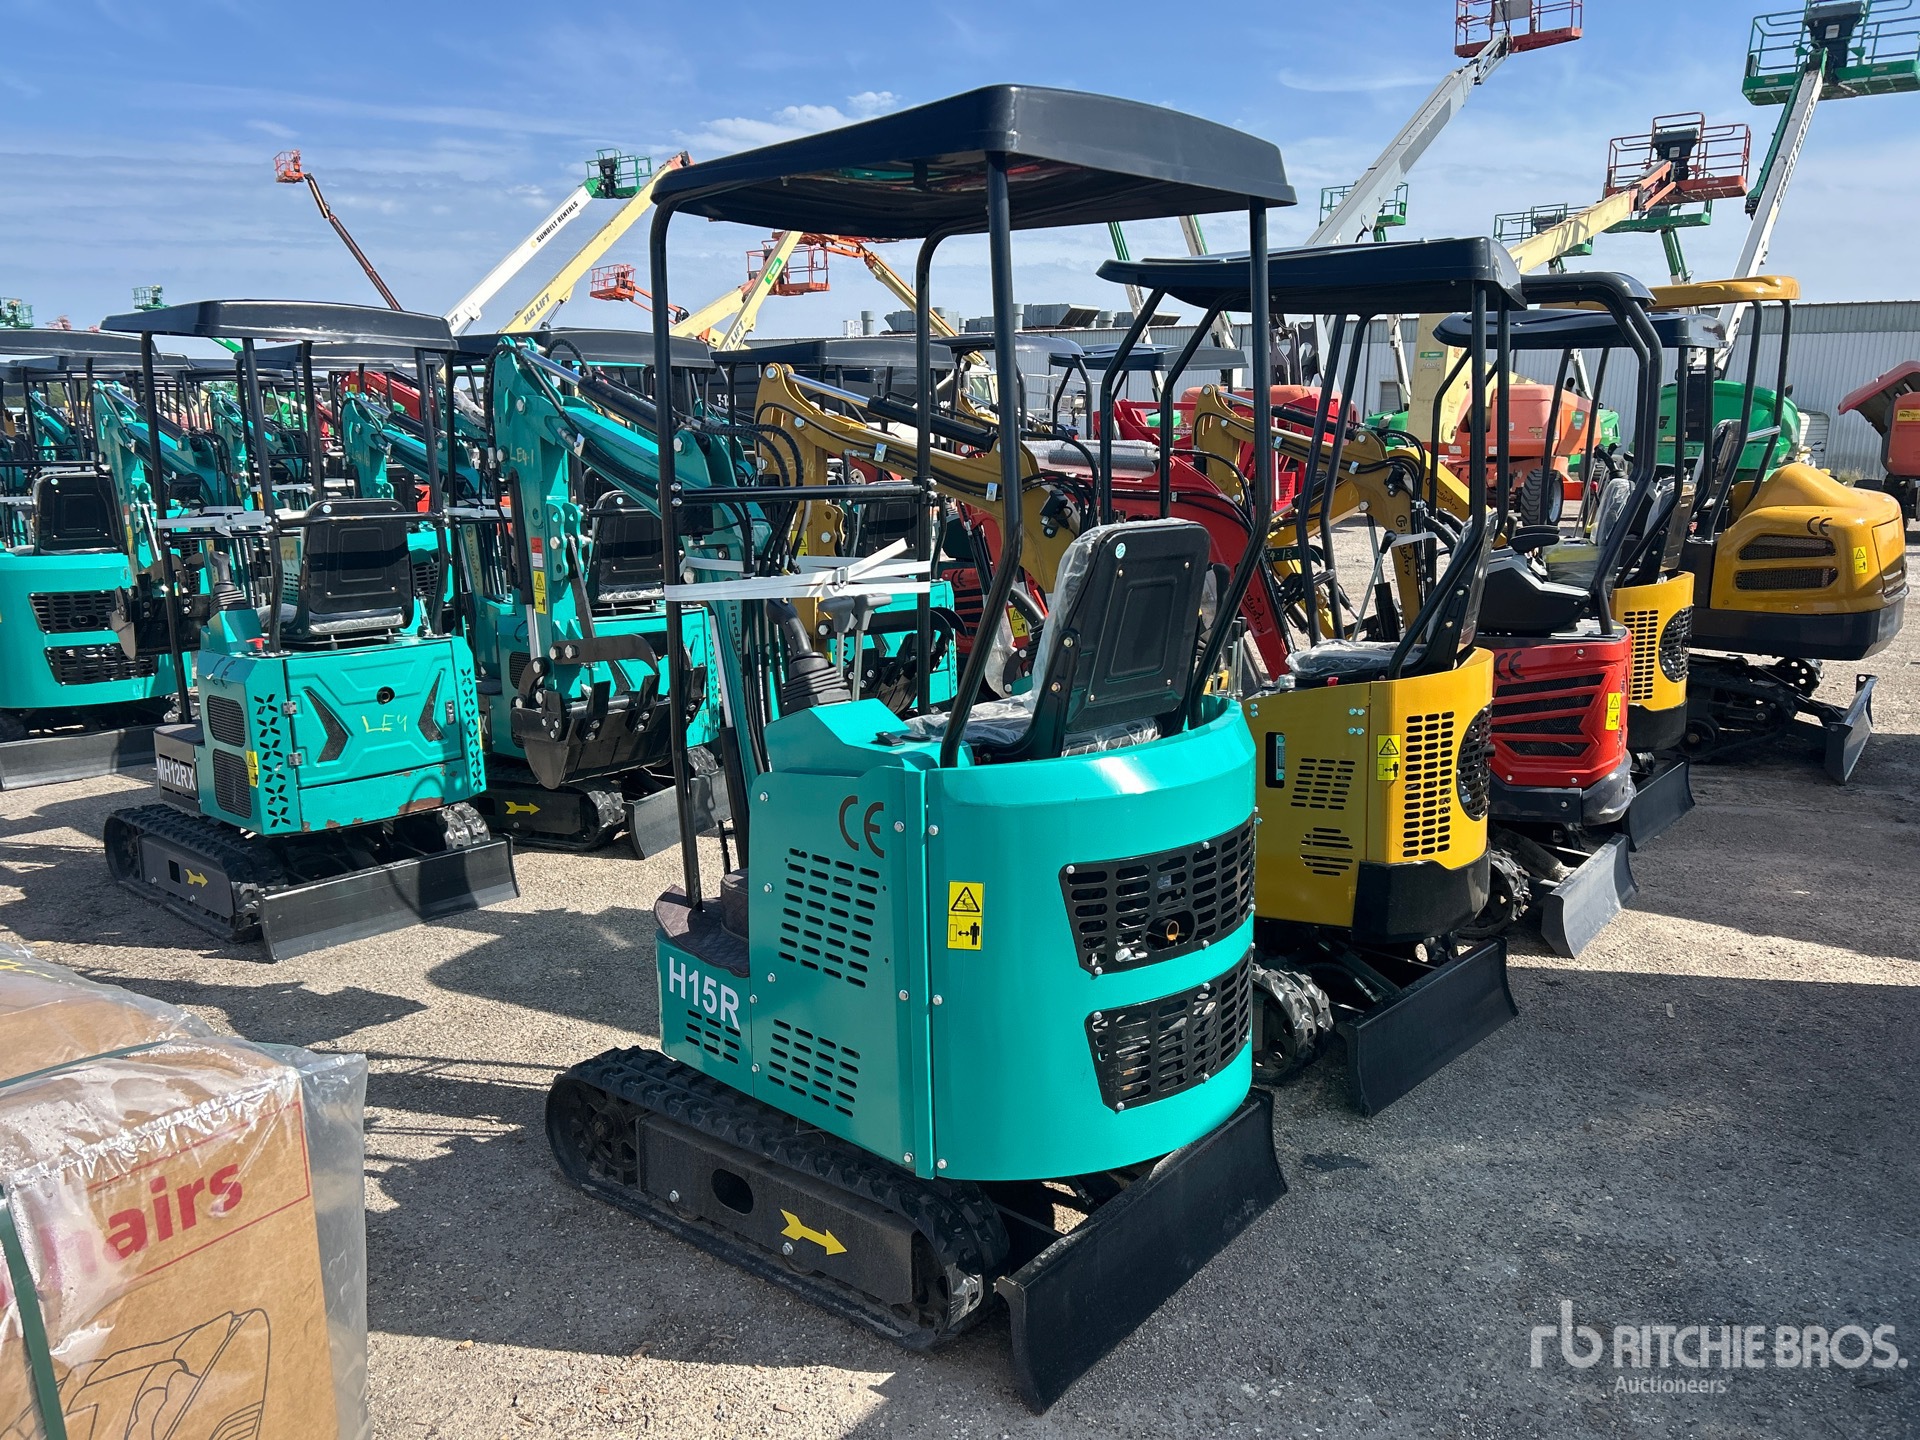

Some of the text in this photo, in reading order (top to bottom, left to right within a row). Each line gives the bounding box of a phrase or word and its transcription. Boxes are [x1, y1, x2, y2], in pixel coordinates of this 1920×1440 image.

[536, 201, 579, 243] SUNBELT RENTALS
[524, 293, 551, 325] JLG LIFT
[730, 320, 744, 346] LIFT
[1806, 515, 1833, 537] CE
[1495, 650, 1526, 682] CE
[156, 757, 196, 791] MH12RX
[838, 795, 885, 859] CE
[667, 956, 742, 1031] H15R
